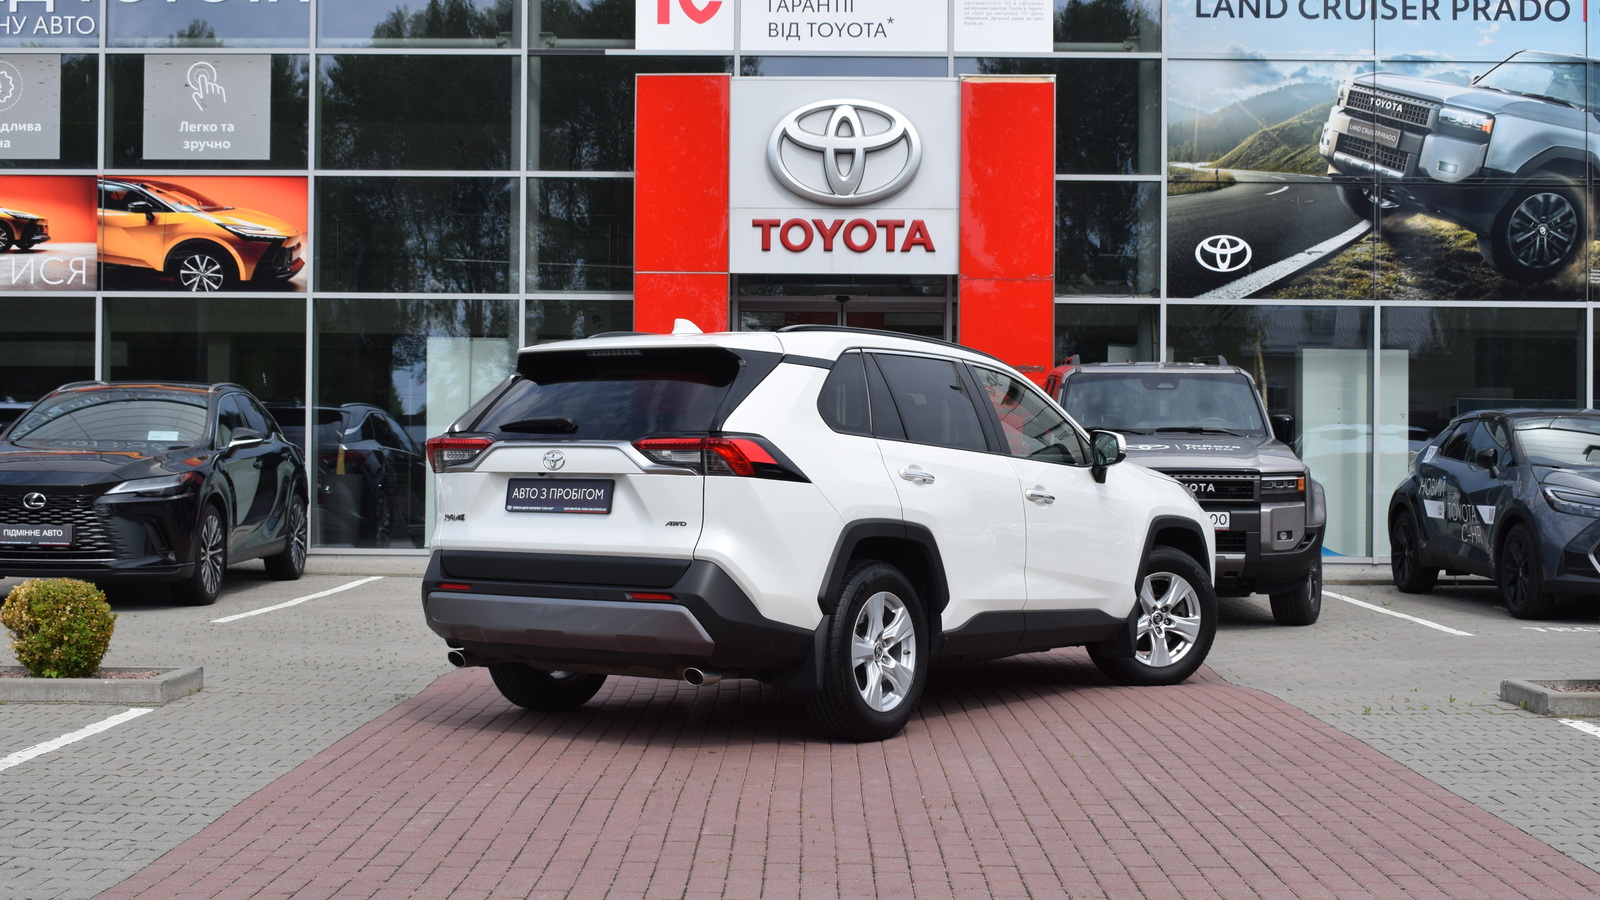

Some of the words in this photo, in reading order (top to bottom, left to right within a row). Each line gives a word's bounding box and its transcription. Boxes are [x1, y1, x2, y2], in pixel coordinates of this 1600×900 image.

[1195, 0, 1289, 19] LAND
[1298, 0, 1441, 21] CRUISER
[1451, 0, 1571, 22] PRADO
[32, 15, 96, 35] АВТО
[768, 22, 801, 41] ВІД
[1369, 97, 1403, 113] TOYOTA
[179, 121, 218, 132] Легко
[220, 123, 235, 132] та
[183, 140, 231, 152] зручно
[752, 218, 936, 253] TOYOTA
[512, 487, 539, 499] АВТО
[549, 488, 604, 500] ПРОБІГОМ
[1419, 475, 1446, 497] НОВИЙ
[1447, 502, 1477, 523] TOYOTA
[3, 528, 41, 538] ПІДМІННЕ
[42, 529, 63, 537] АВТО
[1461, 523, 1484, 545] C-HR
